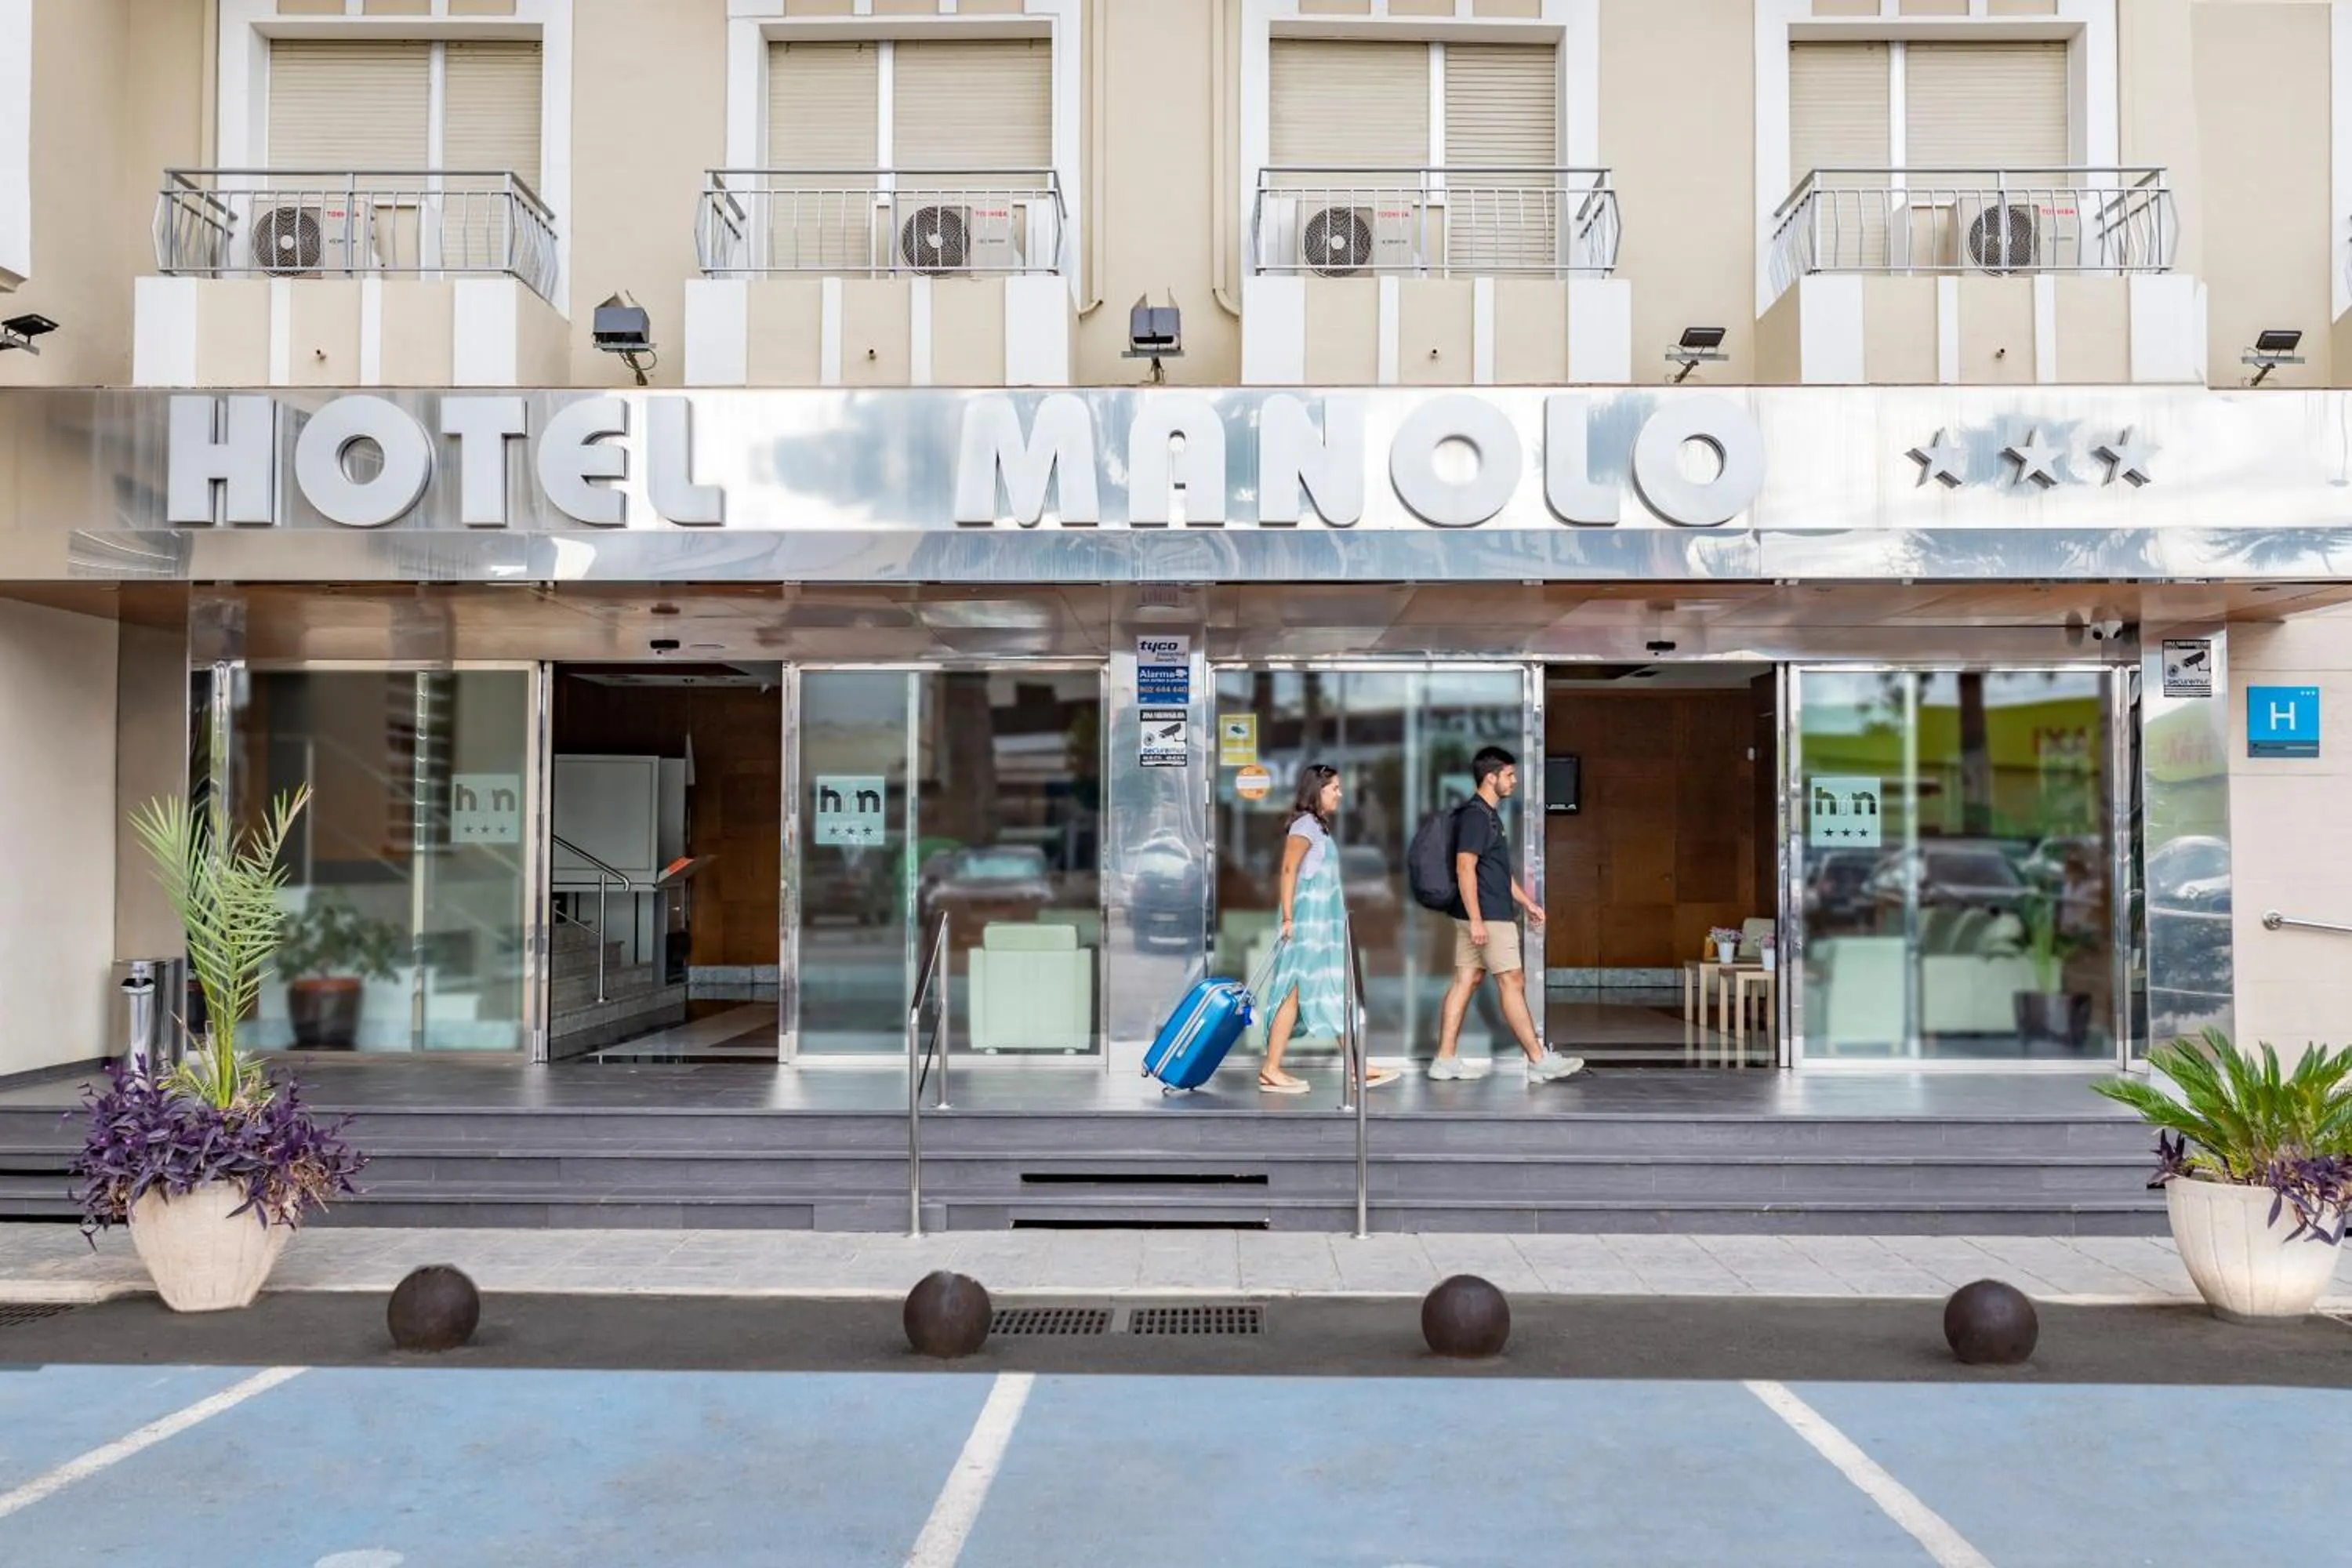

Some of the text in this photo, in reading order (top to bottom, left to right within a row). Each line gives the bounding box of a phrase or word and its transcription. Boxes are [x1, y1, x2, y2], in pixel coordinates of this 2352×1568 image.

[168, 393, 1767, 529] HOTEL MANOLO
[1140, 641, 1178, 652] tyco
[1139, 669, 1176, 679] Alarma
[2270, 702, 2296, 731] H
